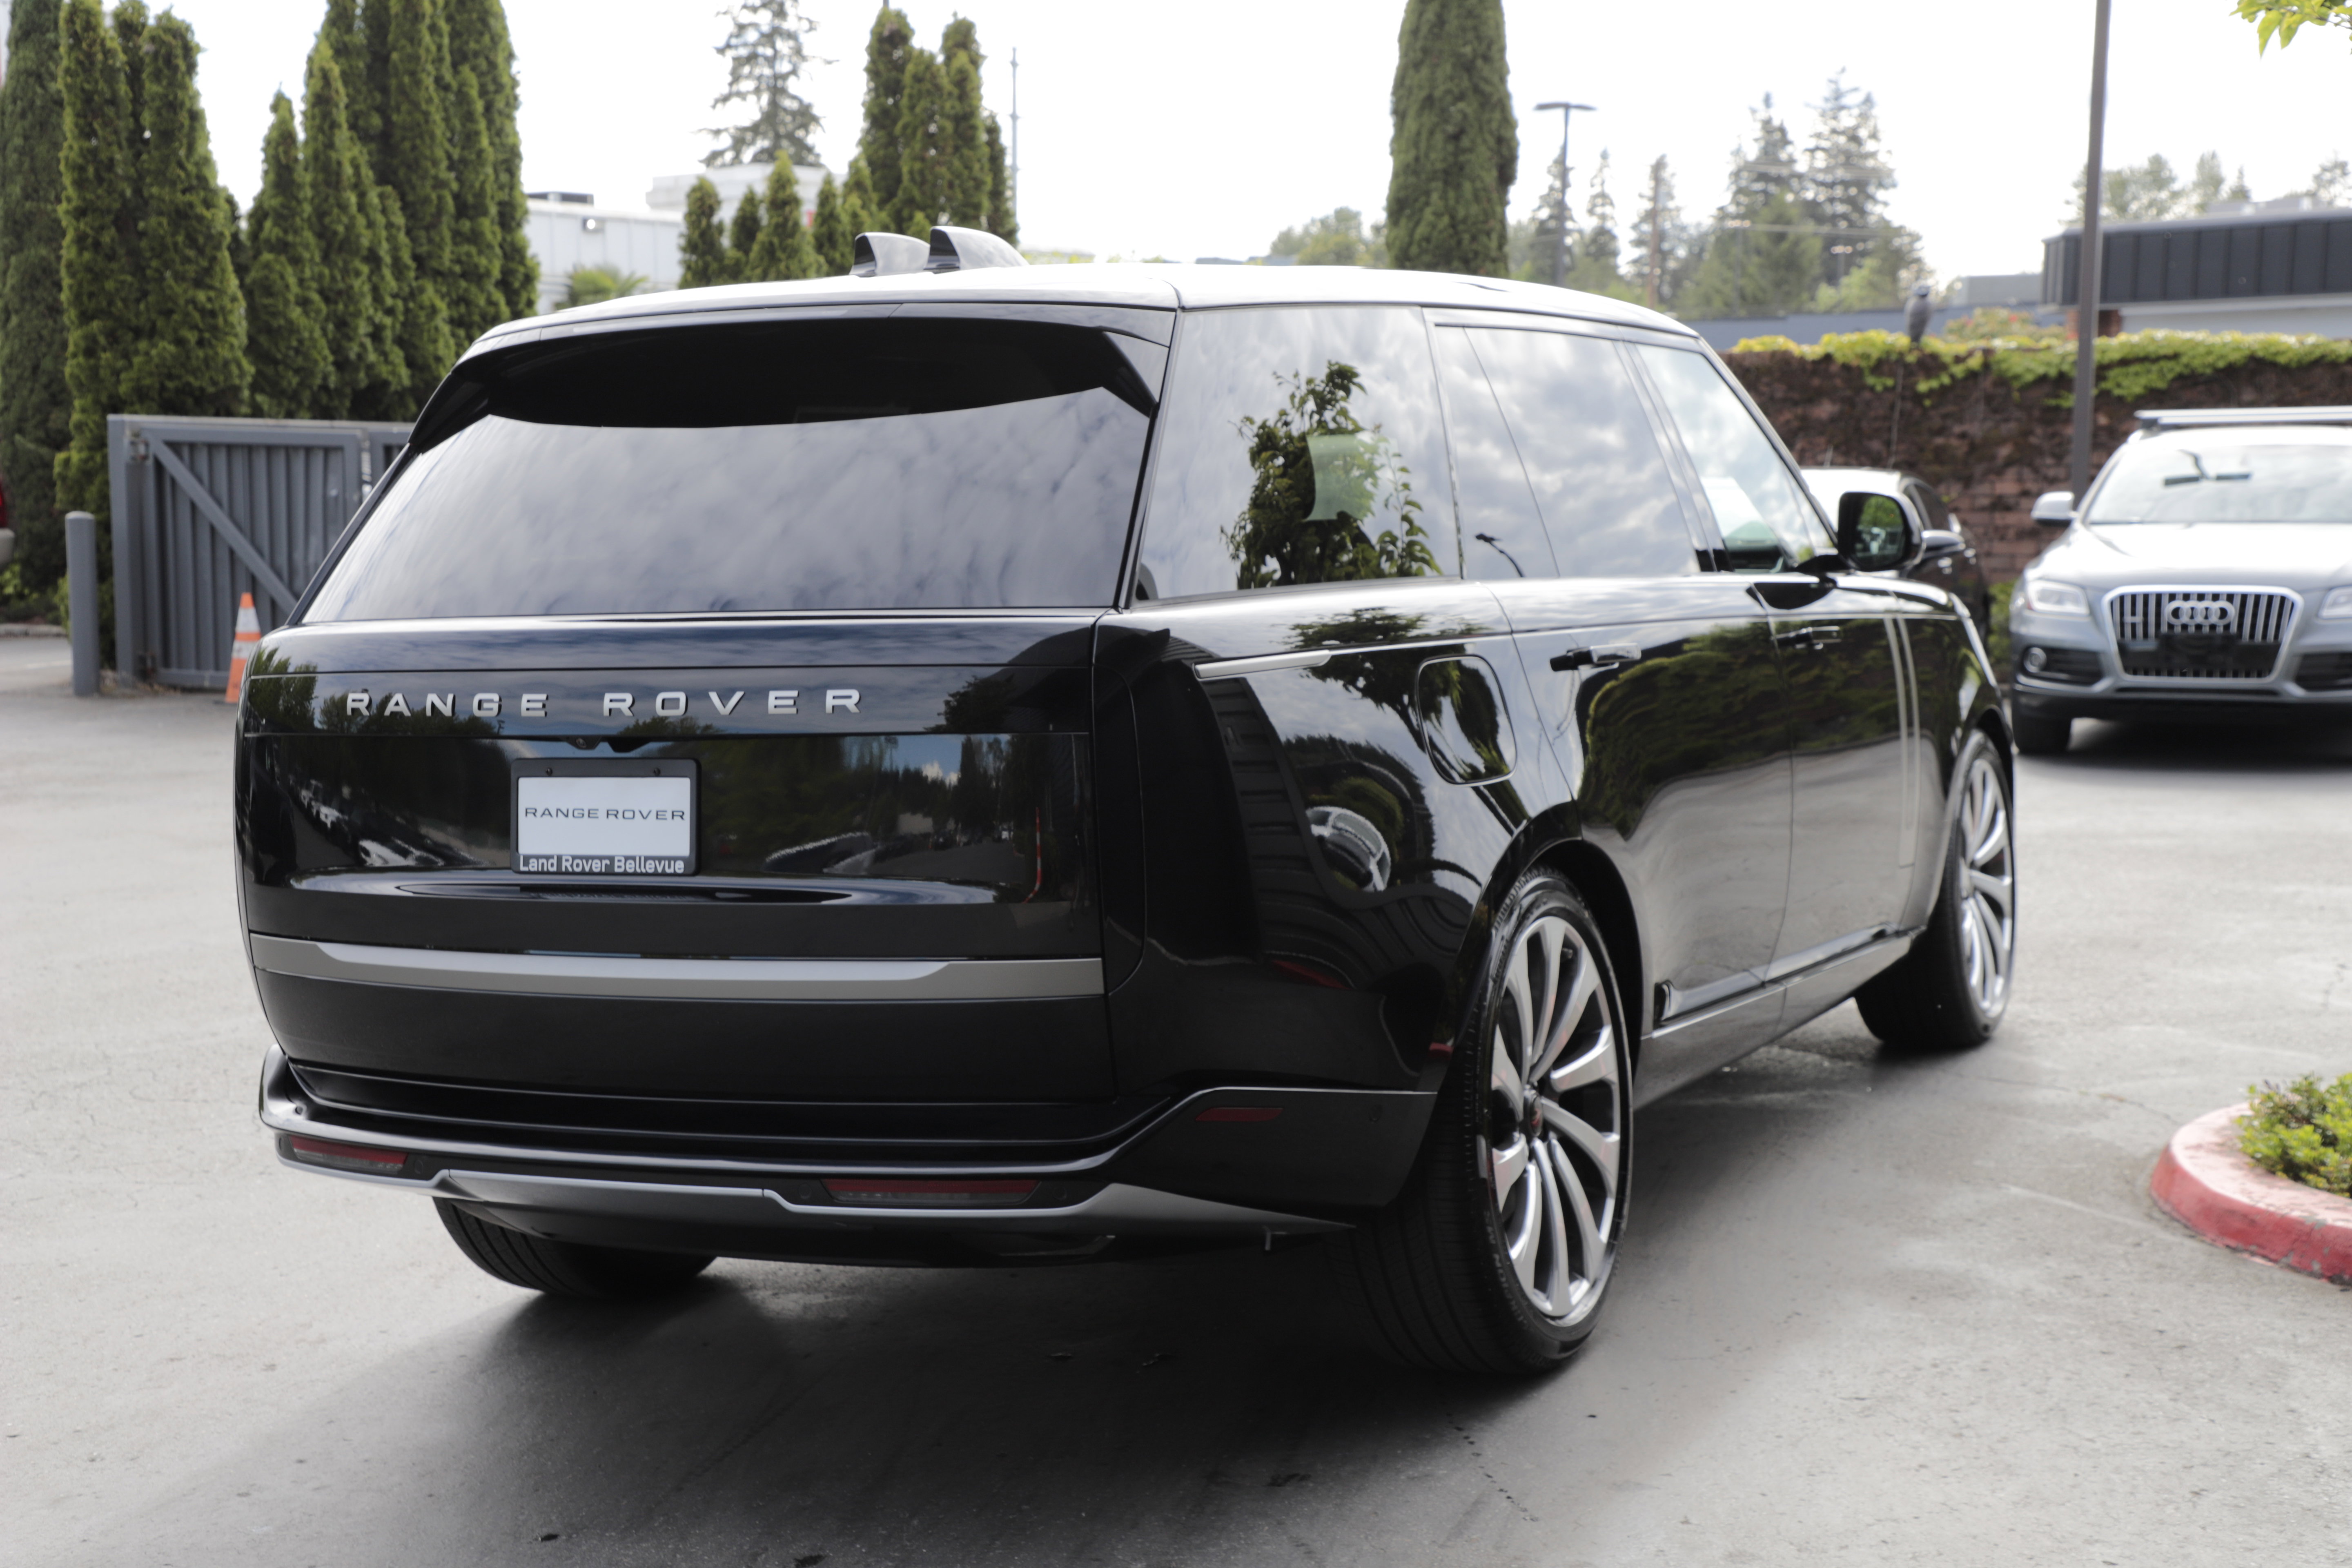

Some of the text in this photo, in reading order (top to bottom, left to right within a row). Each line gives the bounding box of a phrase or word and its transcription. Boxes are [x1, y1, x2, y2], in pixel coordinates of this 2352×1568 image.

[346, 688, 861, 717] RANGE ROVER
[525, 807, 685, 820] RANGE ROVER
[519, 854, 685, 873] Land Rover Bellevue
